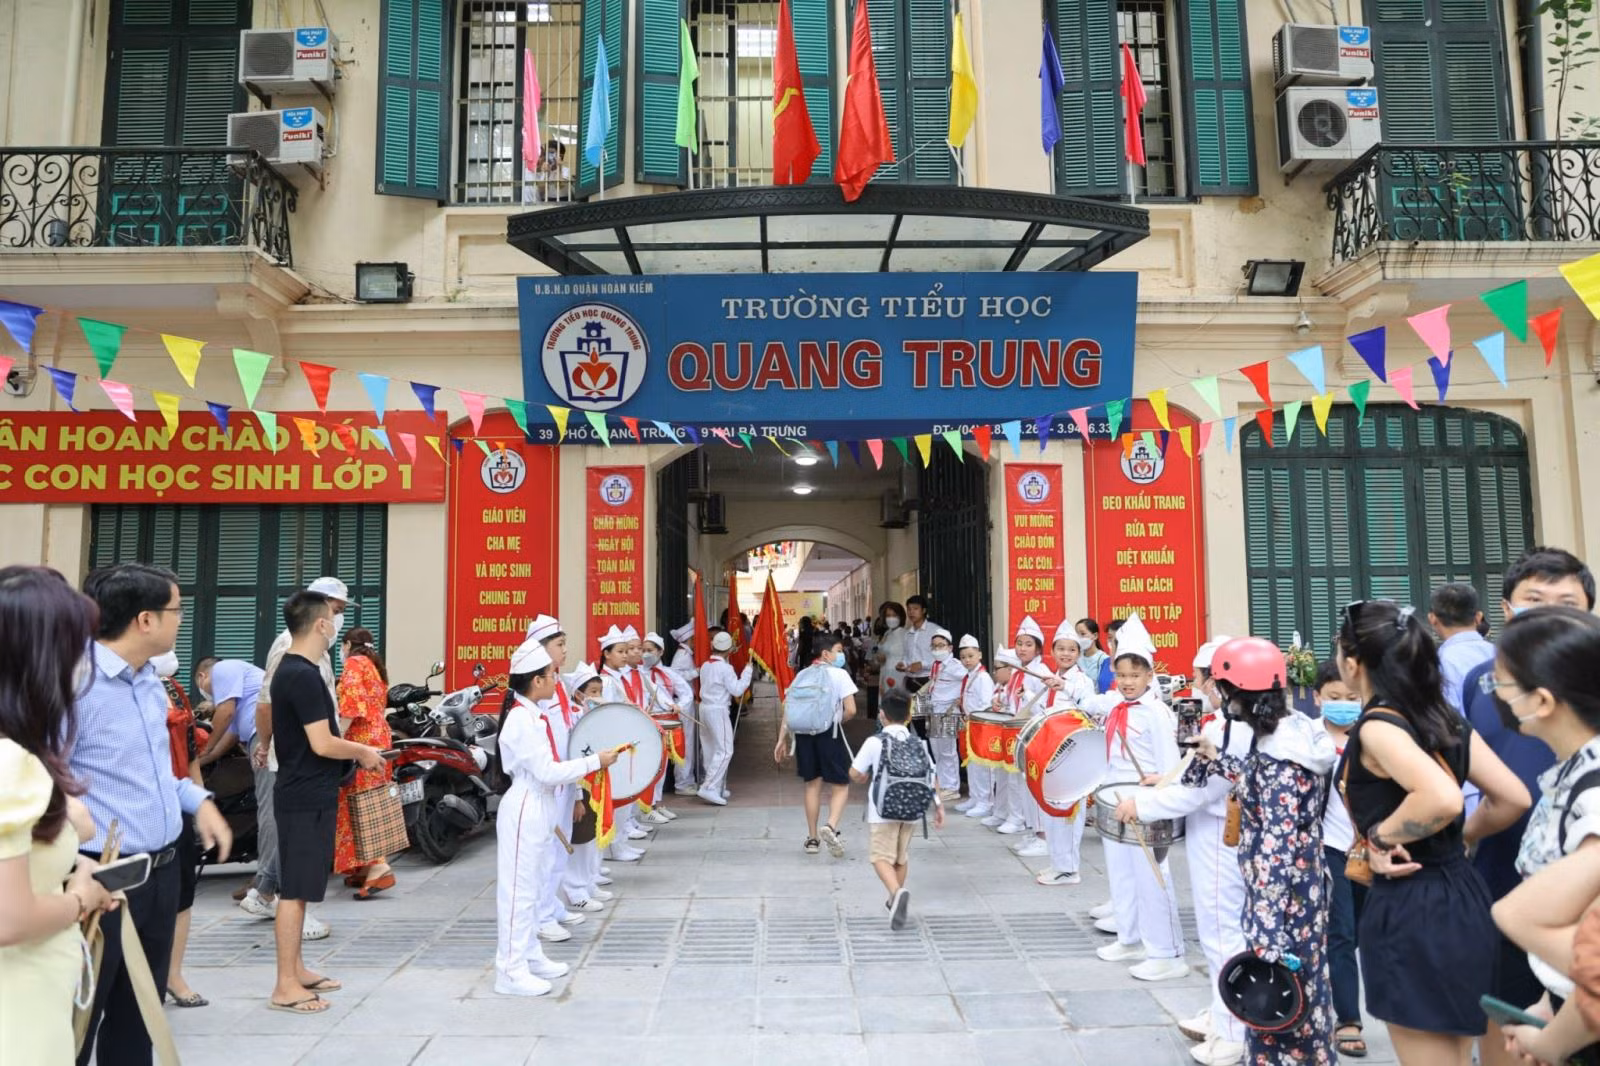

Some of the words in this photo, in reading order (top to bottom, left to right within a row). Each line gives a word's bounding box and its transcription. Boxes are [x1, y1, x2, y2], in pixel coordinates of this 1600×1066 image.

[721, 288, 870, 319] TRƯỜNG
[881, 282, 967, 318] TIỂU
[978, 295, 1052, 324] HỌC
[668, 339, 883, 391] QUANG
[903, 339, 1103, 388] TRUNG
[58, 426, 169, 451] HOAN
[181, 418, 291, 451] CHÀO
[300, 418, 386, 451] ĐÓN
[539, 428, 553, 439] 39
[701, 427, 709, 438] 9
[761, 425, 807, 437] TRƯNG
[24, 464, 107, 490] CON
[119, 464, 201, 497] HỌC
[211, 464, 300, 490] SINH
[312, 456, 388, 490] LỚP
[398, 464, 412, 489] 1
[1102, 495, 1122, 510] ĐEO
[1153, 495, 1185, 510] TRANG
[482, 506, 503, 523] GIÁO
[505, 506, 526, 523] VIÊN
[1014, 514, 1028, 527] VUI
[1147, 522, 1165, 537] TAY
[486, 536, 505, 551] CHA
[506, 536, 521, 554] MẸ
[598, 535, 619, 552] NGÀY
[1014, 532, 1036, 549] CHÀO
[1037, 532, 1055, 549] ĐÓN
[597, 556, 617, 573] TOÀN
[619, 556, 636, 573] DÂN
[1017, 554, 1034, 570] CÁC
[1035, 556, 1053, 570] CON
[1116, 547, 1139, 568] DIỆT
[475, 560, 488, 578] VÀ
[489, 563, 508, 581] HỌC
[509, 563, 532, 578] SINH
[1016, 577, 1033, 594] HỌC
[1034, 577, 1055, 592] SINH
[1146, 575, 1174, 592] CÁCH
[479, 590, 510, 605] CHUNG
[511, 590, 527, 605] TAY
[1042, 599, 1046, 613] 1
[1112, 602, 1147, 621] KHÔNG
[1148, 605, 1162, 623] TỤ
[1163, 602, 1183, 623] TẬP
[472, 615, 497, 632] CÙNG
[519, 615, 533, 632] LÙ
[457, 645, 479, 663] DỊCH
[480, 642, 505, 663] BỆNH
